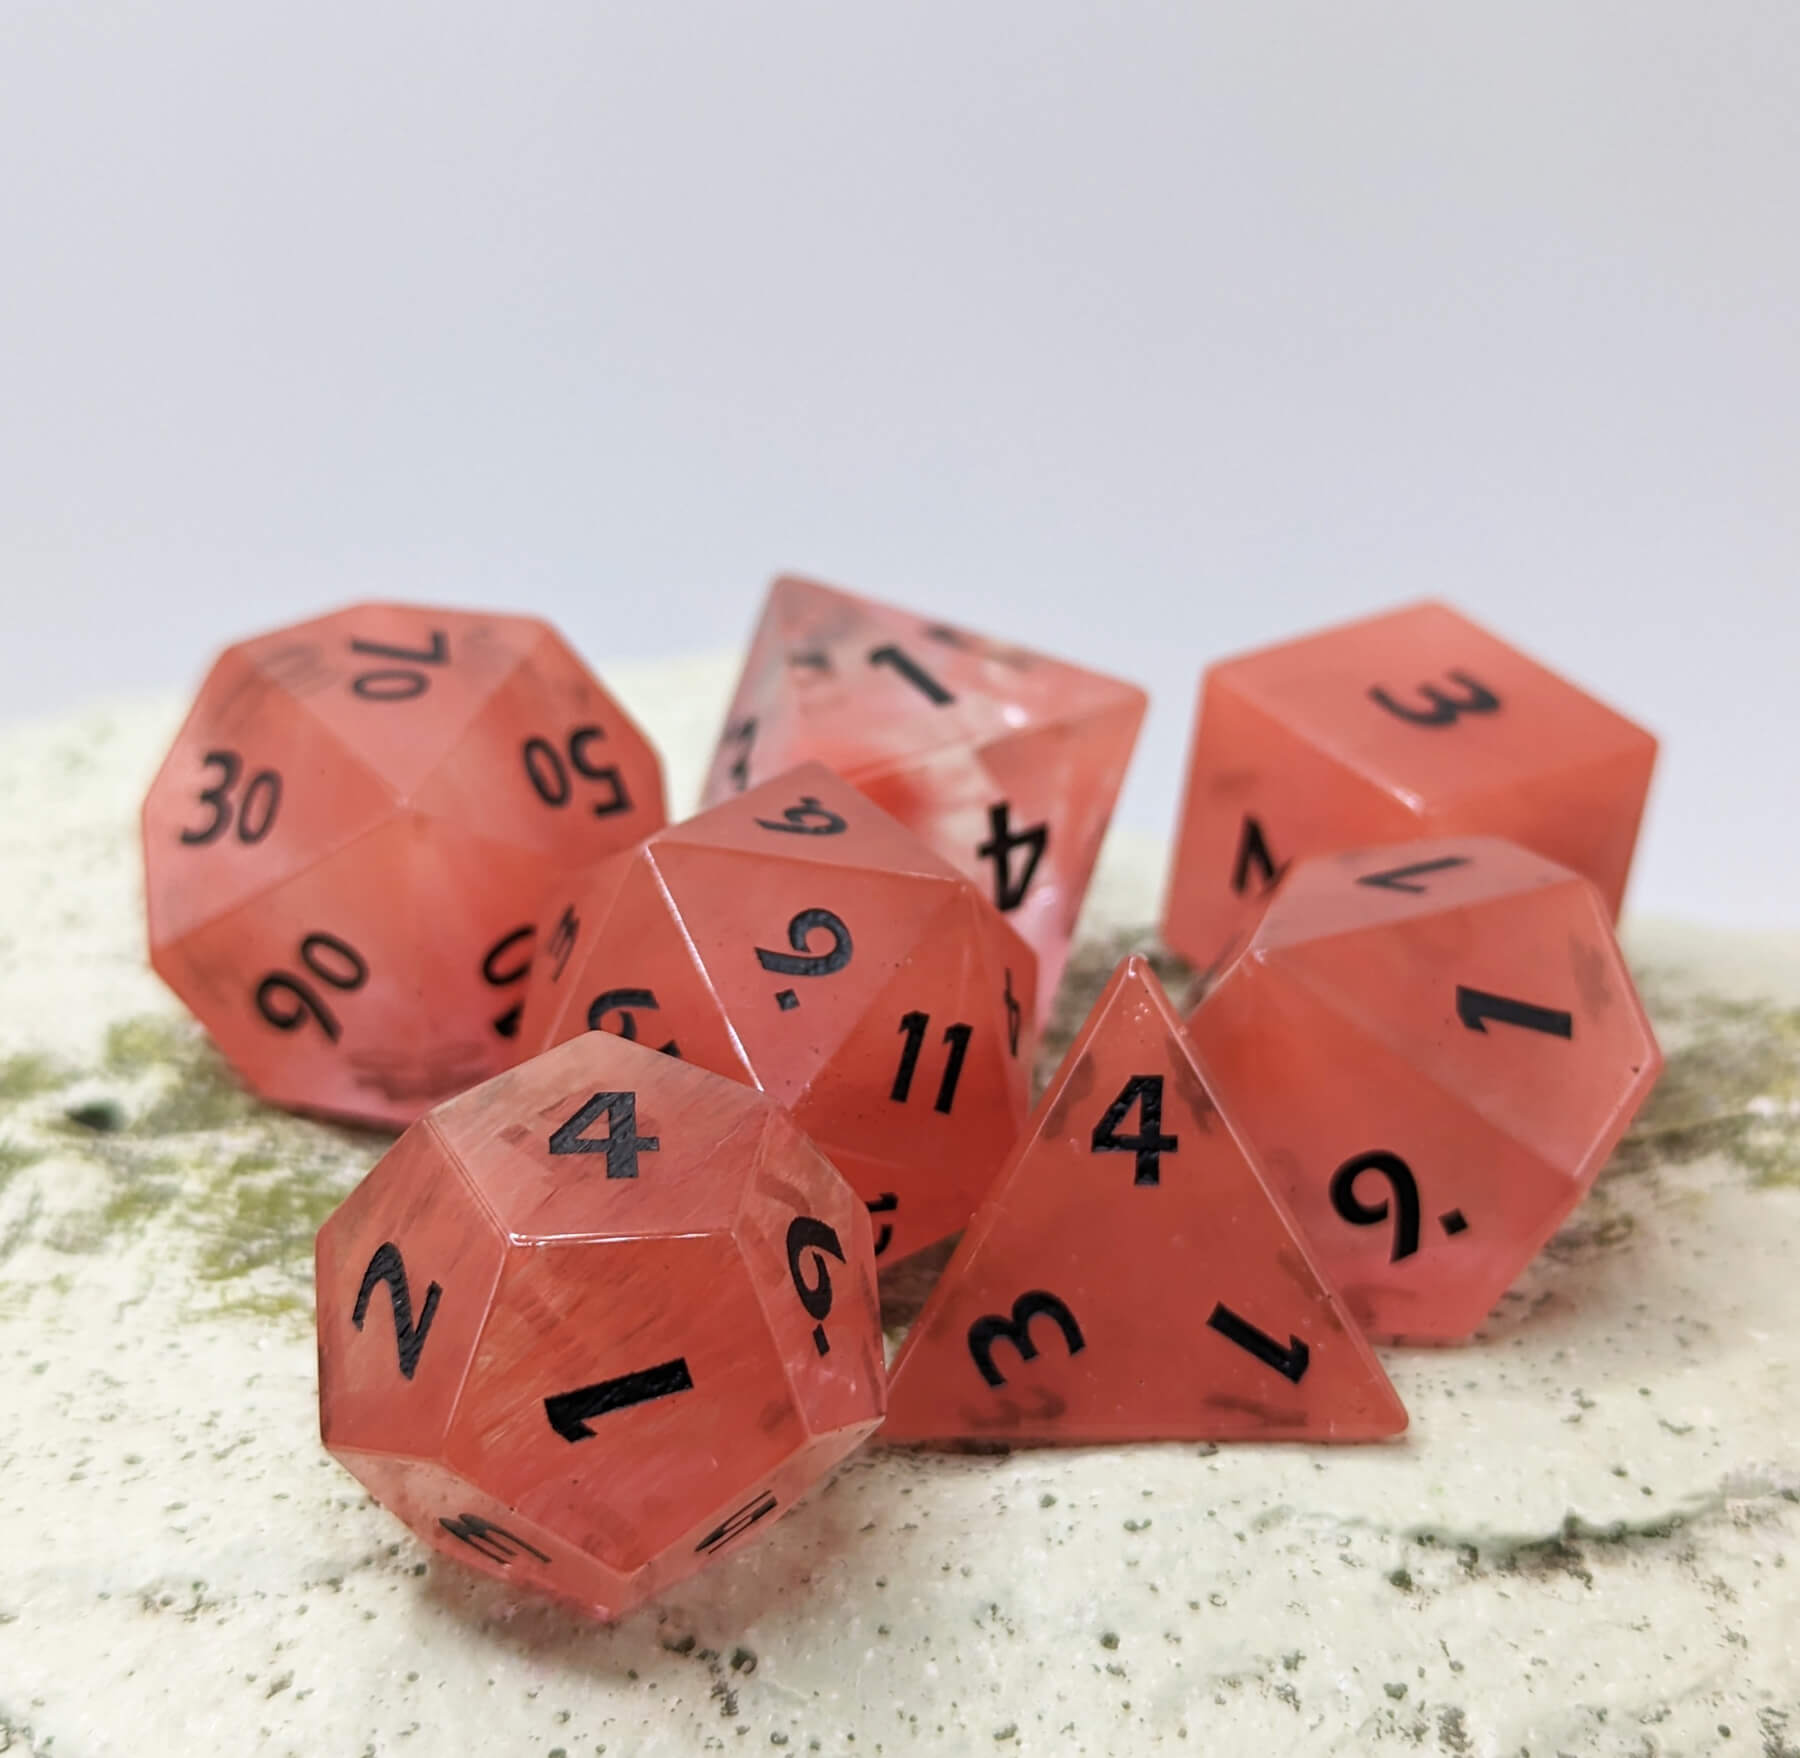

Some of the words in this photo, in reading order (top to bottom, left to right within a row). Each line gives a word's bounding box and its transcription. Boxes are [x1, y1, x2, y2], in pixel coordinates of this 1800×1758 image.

[349, 630, 449, 702] 70
[868, 644, 955, 706] 1
[1367, 668, 1503, 728] 3
[179, 750, 282, 846] 30
[521, 725, 633, 818] 50
[978, 802, 1049, 913] 4
[254, 932, 369, 1043] 90
[1457, 985, 1573, 1041] 1
[890, 1010, 973, 1115] 11
[548, 1091, 660, 1180] 4
[1090, 1074, 1179, 1186] 4
[351, 1241, 443, 1382] 2
[967, 1290, 1086, 1389] 3
[1207, 1303, 1310, 1385] 1
[544, 1357, 695, 1443] 1
